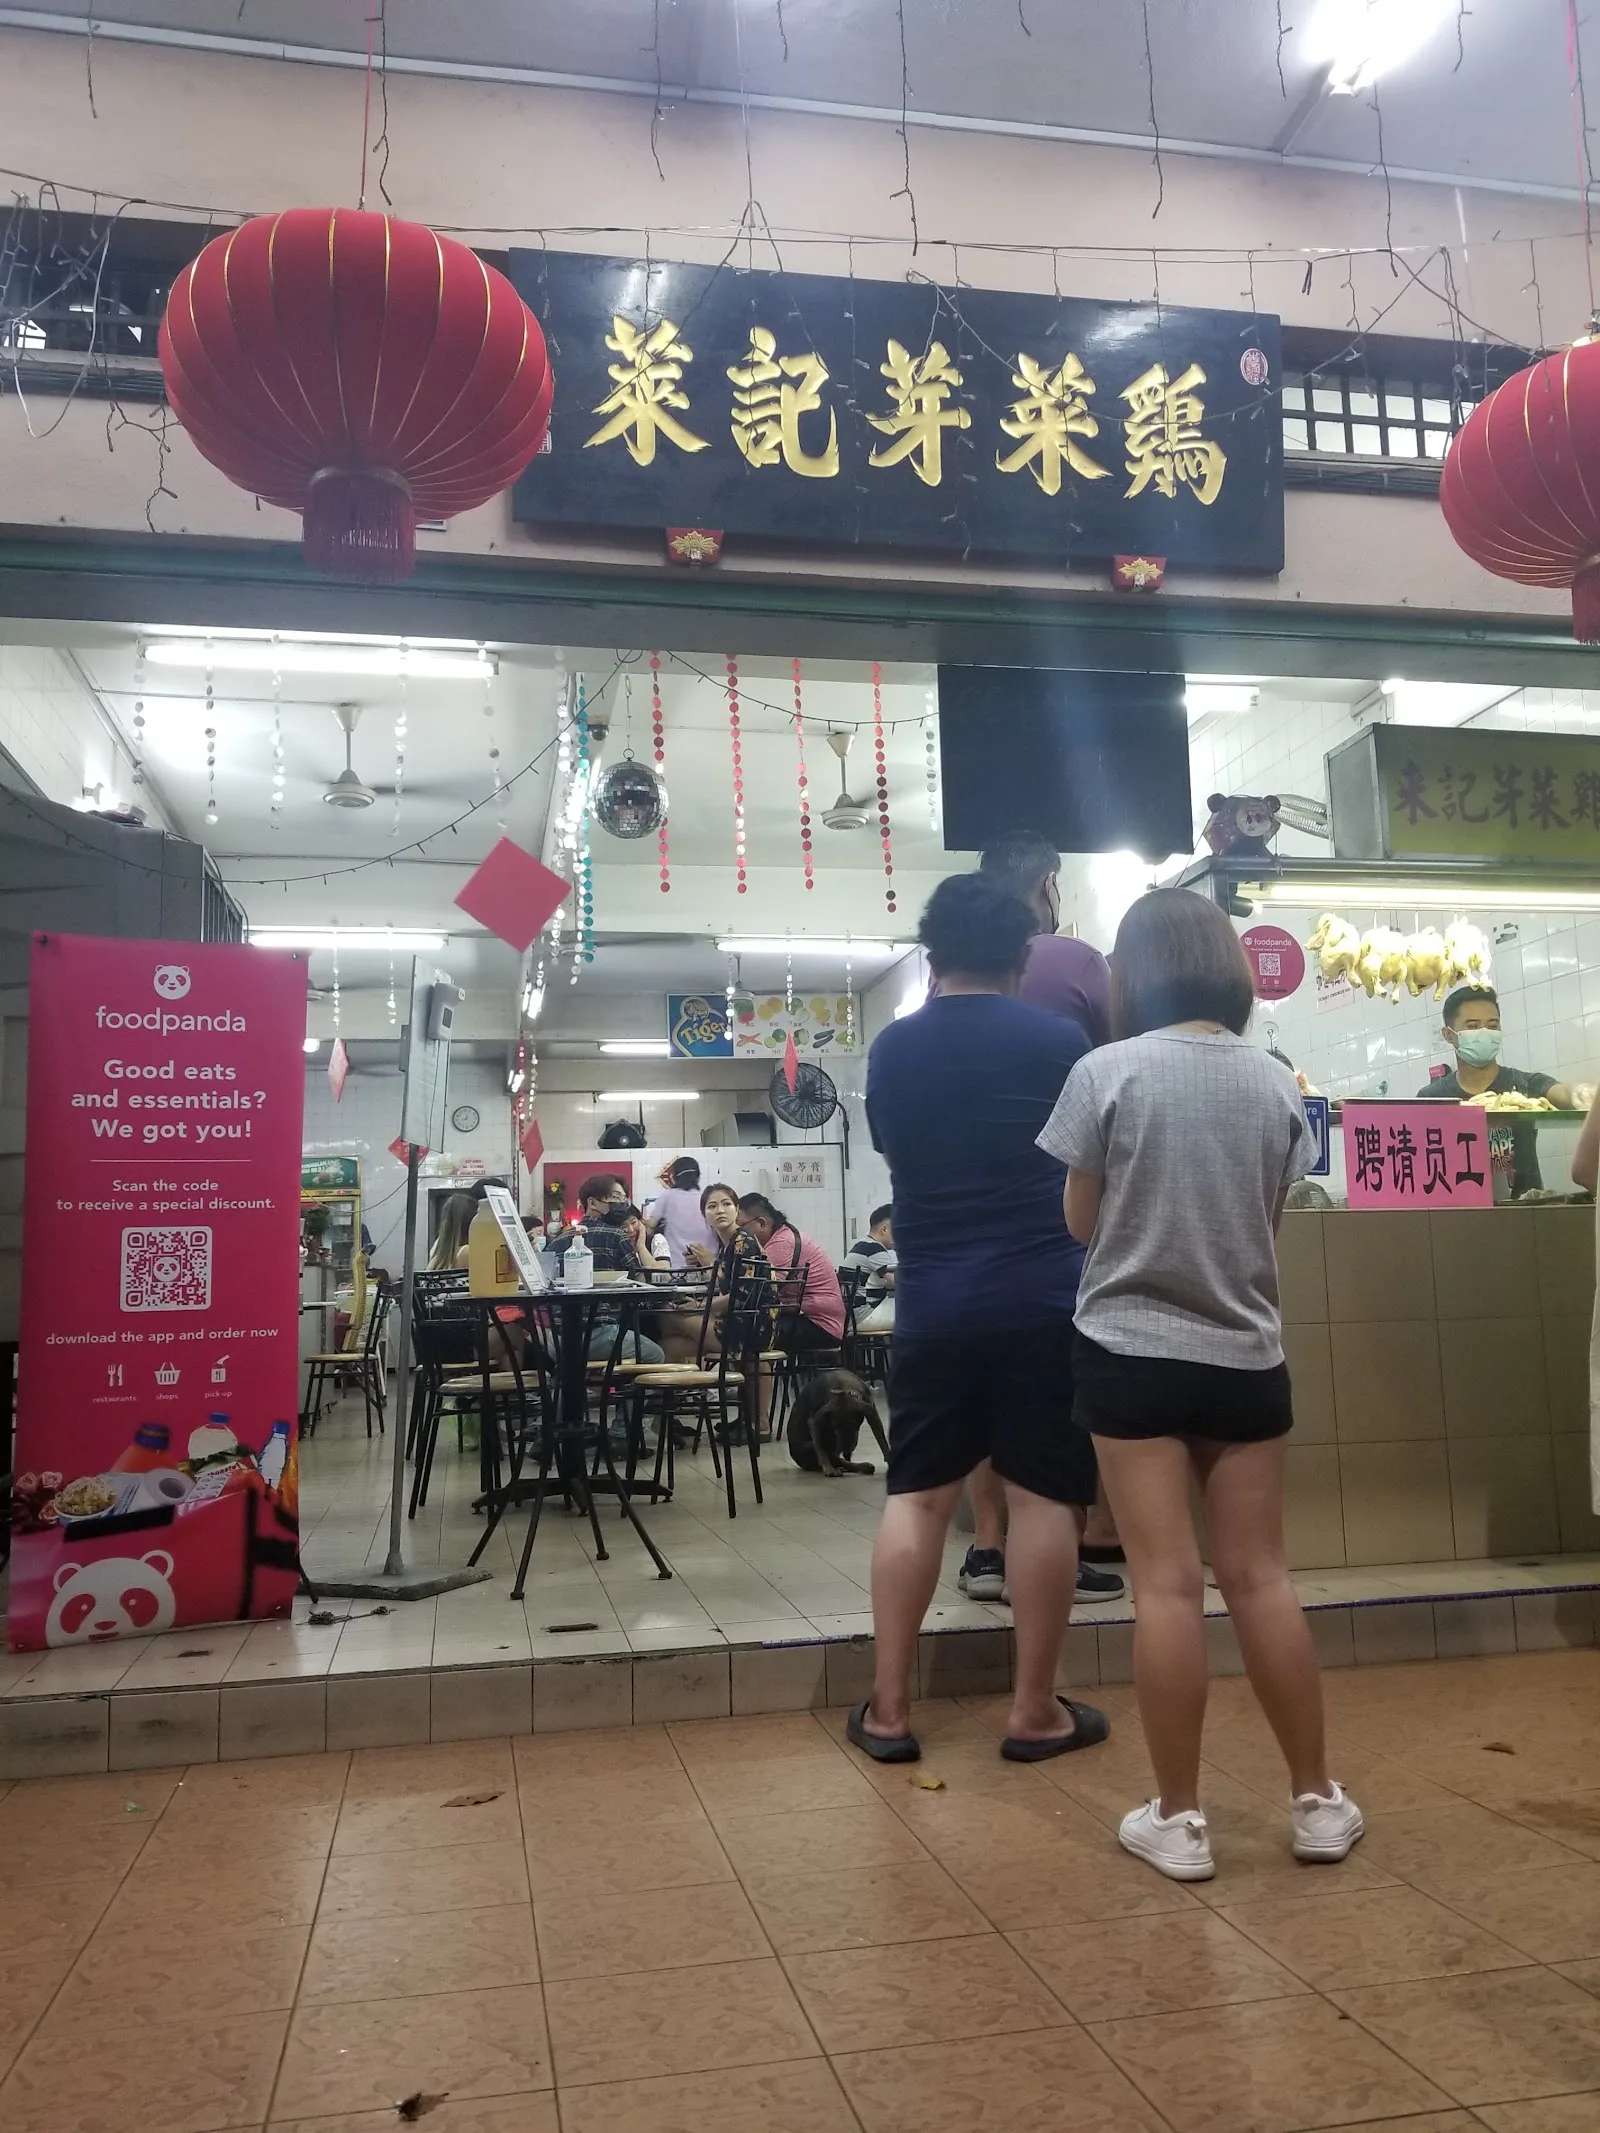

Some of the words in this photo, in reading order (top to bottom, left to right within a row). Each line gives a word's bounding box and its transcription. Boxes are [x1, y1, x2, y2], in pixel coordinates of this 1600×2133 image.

[1254, 938, 1291, 947] foodpanda
[96, 1005, 246, 1036] foodpanda
[681, 1019, 726, 1045] Tiger
[104, 1059, 174, 1079] Good
[184, 1063, 236, 1080] eats
[71, 1089, 118, 1108] and
[128, 1090, 266, 1109] essentials?
[91, 1119, 133, 1138] We
[143, 1122, 187, 1143] got
[196, 1120, 251, 1143] you!
[1354, 1123, 1485, 1194] 聘请员工
[112, 1180, 148, 1192] Scan
[153, 1179, 177, 1191] the
[183, 1179, 218, 1191] code
[56, 1200, 73, 1210] to
[78, 1199, 133, 1211] receive
[138, 1201, 147, 1210] a
[153, 1198, 204, 1213] special
[208, 1198, 275, 1210] discount.
[46, 1332, 116, 1345] download
[121, 1331, 143, 1343] the
[148, 1332, 175, 1344] app
[179, 1329, 204, 1341] and
[209, 1328, 246, 1340] order
[250, 1328, 278, 1338] now
[92, 1394, 136, 1403] restaurants
[156, 1392, 178, 1401] shops
[204, 1390, 232, 1399] pick-up
